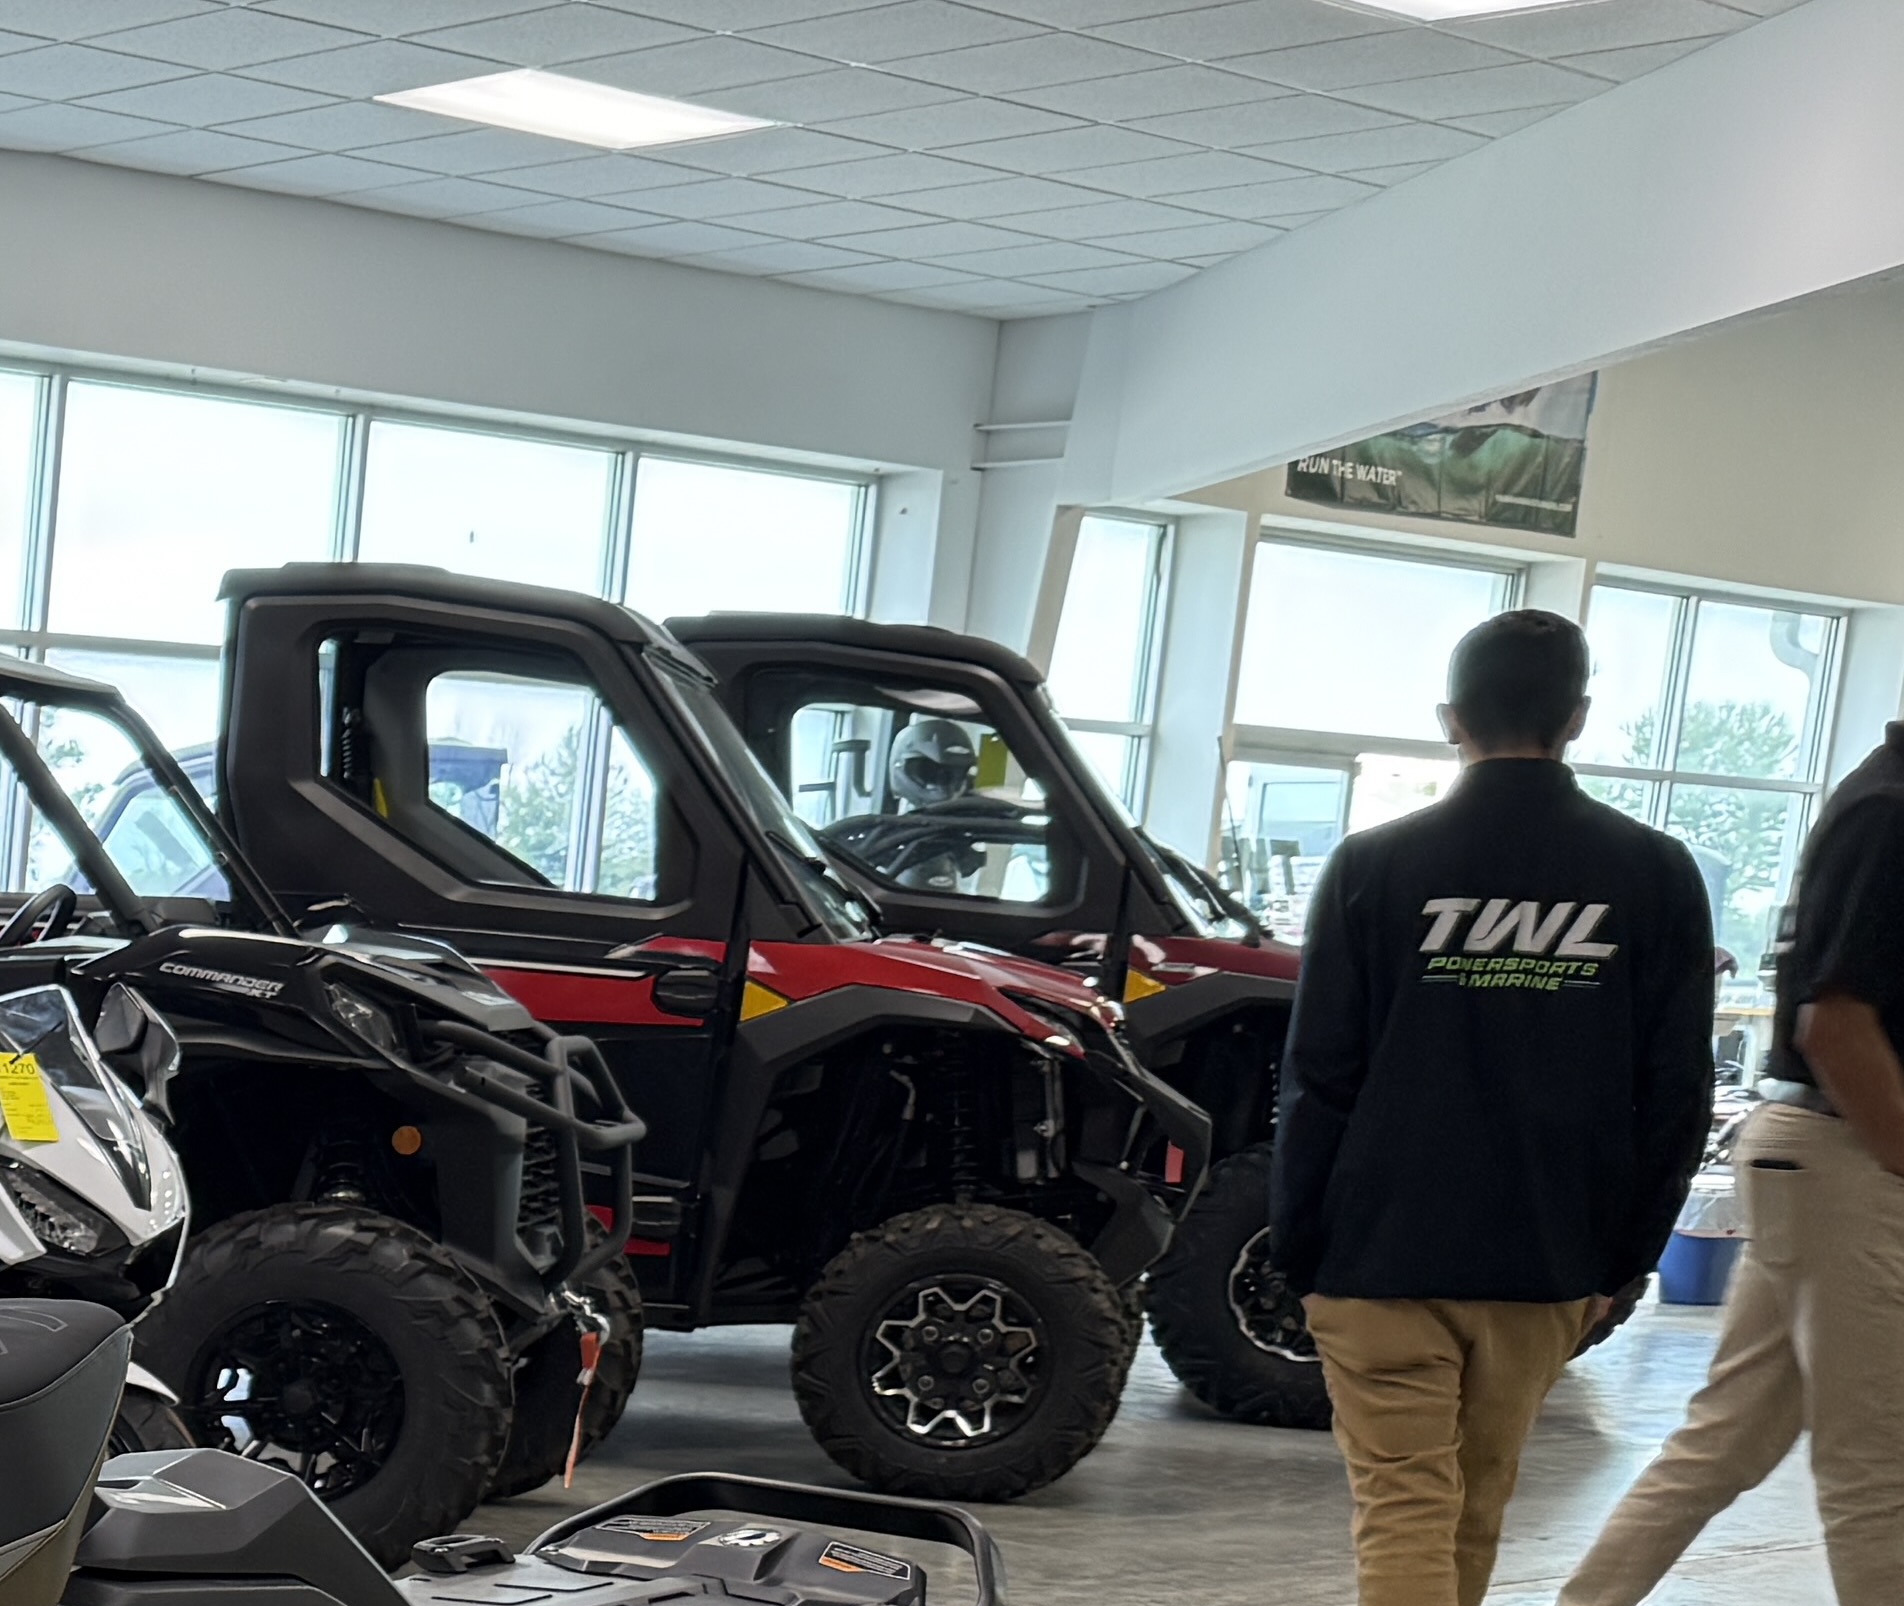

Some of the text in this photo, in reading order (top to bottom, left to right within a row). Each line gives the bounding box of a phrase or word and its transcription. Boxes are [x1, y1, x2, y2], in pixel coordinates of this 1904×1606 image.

[1297, 456, 1330, 473] RUN
[1332, 459, 1353, 480] THE
[1419, 897, 1619, 959] TWL
[159, 962, 285, 992] COMMANDER
[1427, 957, 1599, 976] POWERSPORTS
[1468, 973, 1563, 991] MARINE
